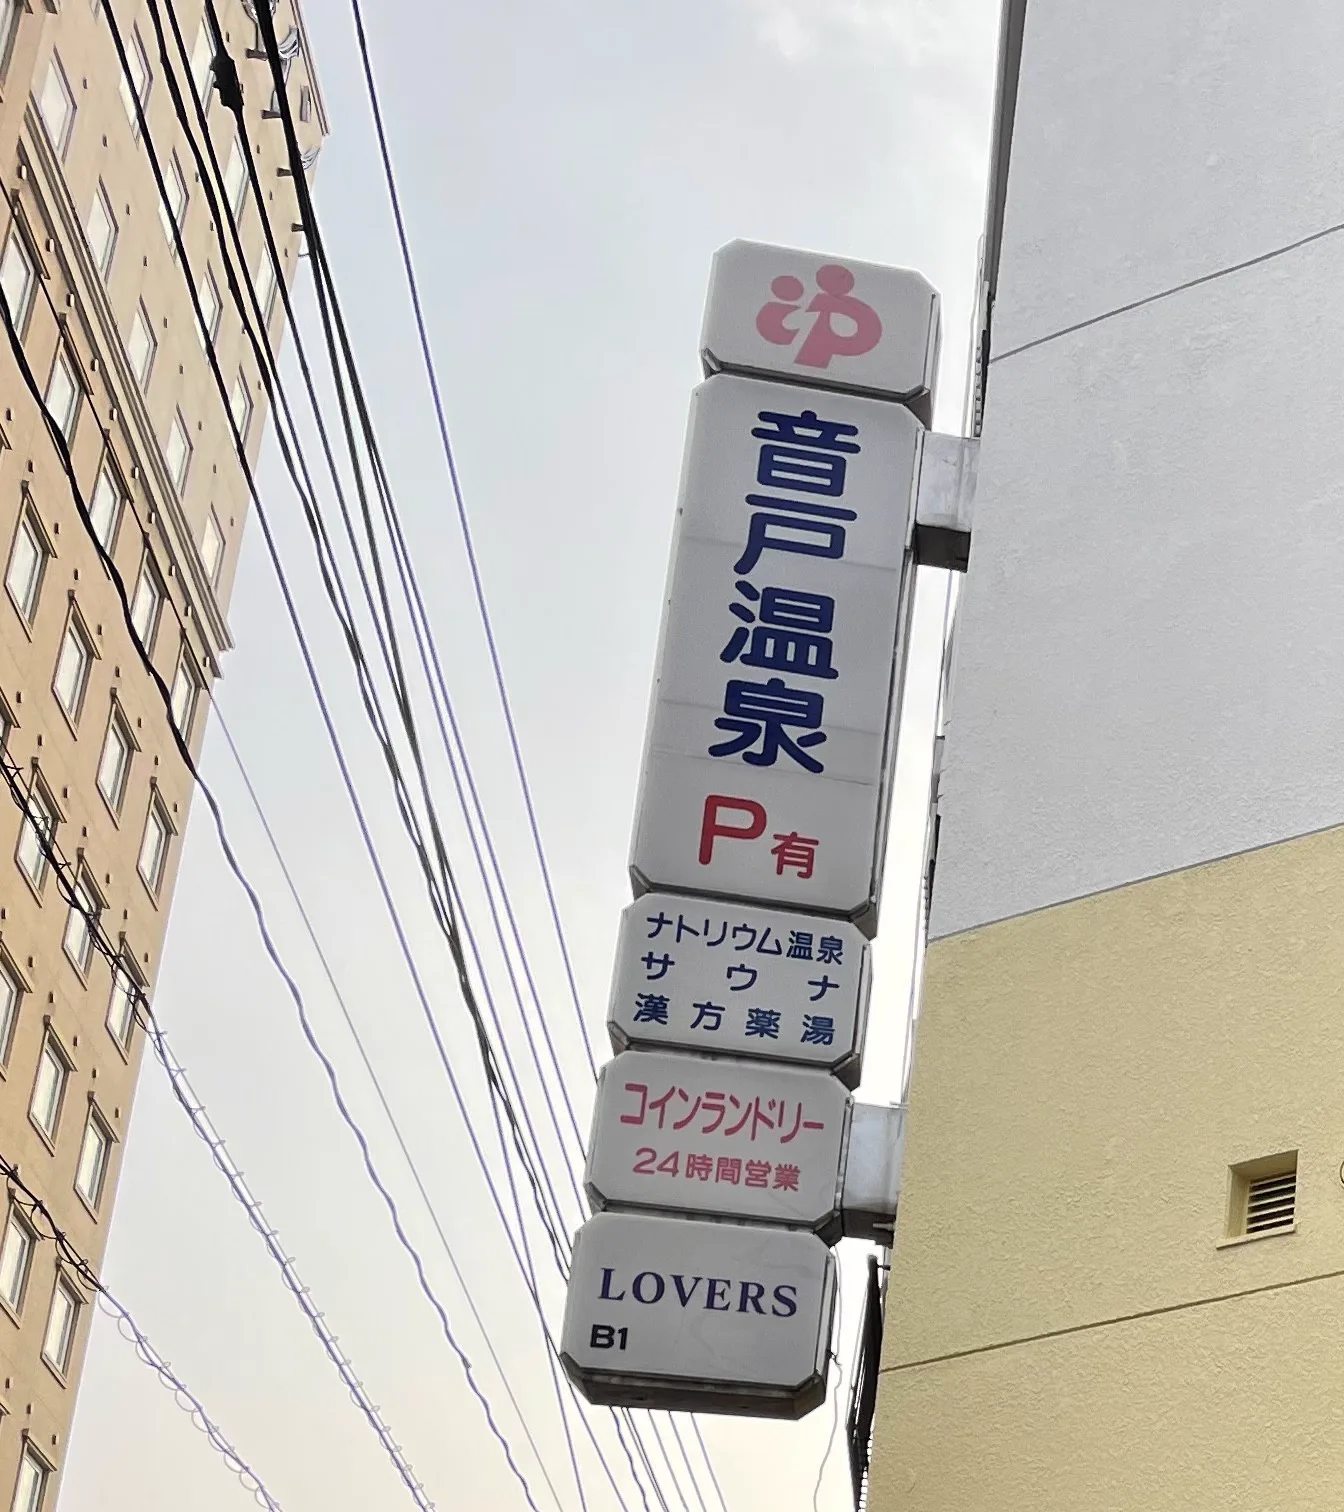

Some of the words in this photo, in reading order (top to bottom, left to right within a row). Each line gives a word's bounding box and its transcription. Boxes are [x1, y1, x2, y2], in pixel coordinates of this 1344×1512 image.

[708, 409, 862, 775] 音戸温泉
[646, 911, 844, 966] ナトリウム温泉
[633, 992, 837, 1046] 漢方薬湯
[619, 1082, 826, 1146] コインランドリー
[632, 1147, 802, 1192] 24時間営業
[599, 1266, 799, 1319] LOVERS
[590, 1323, 629, 1352] B1
